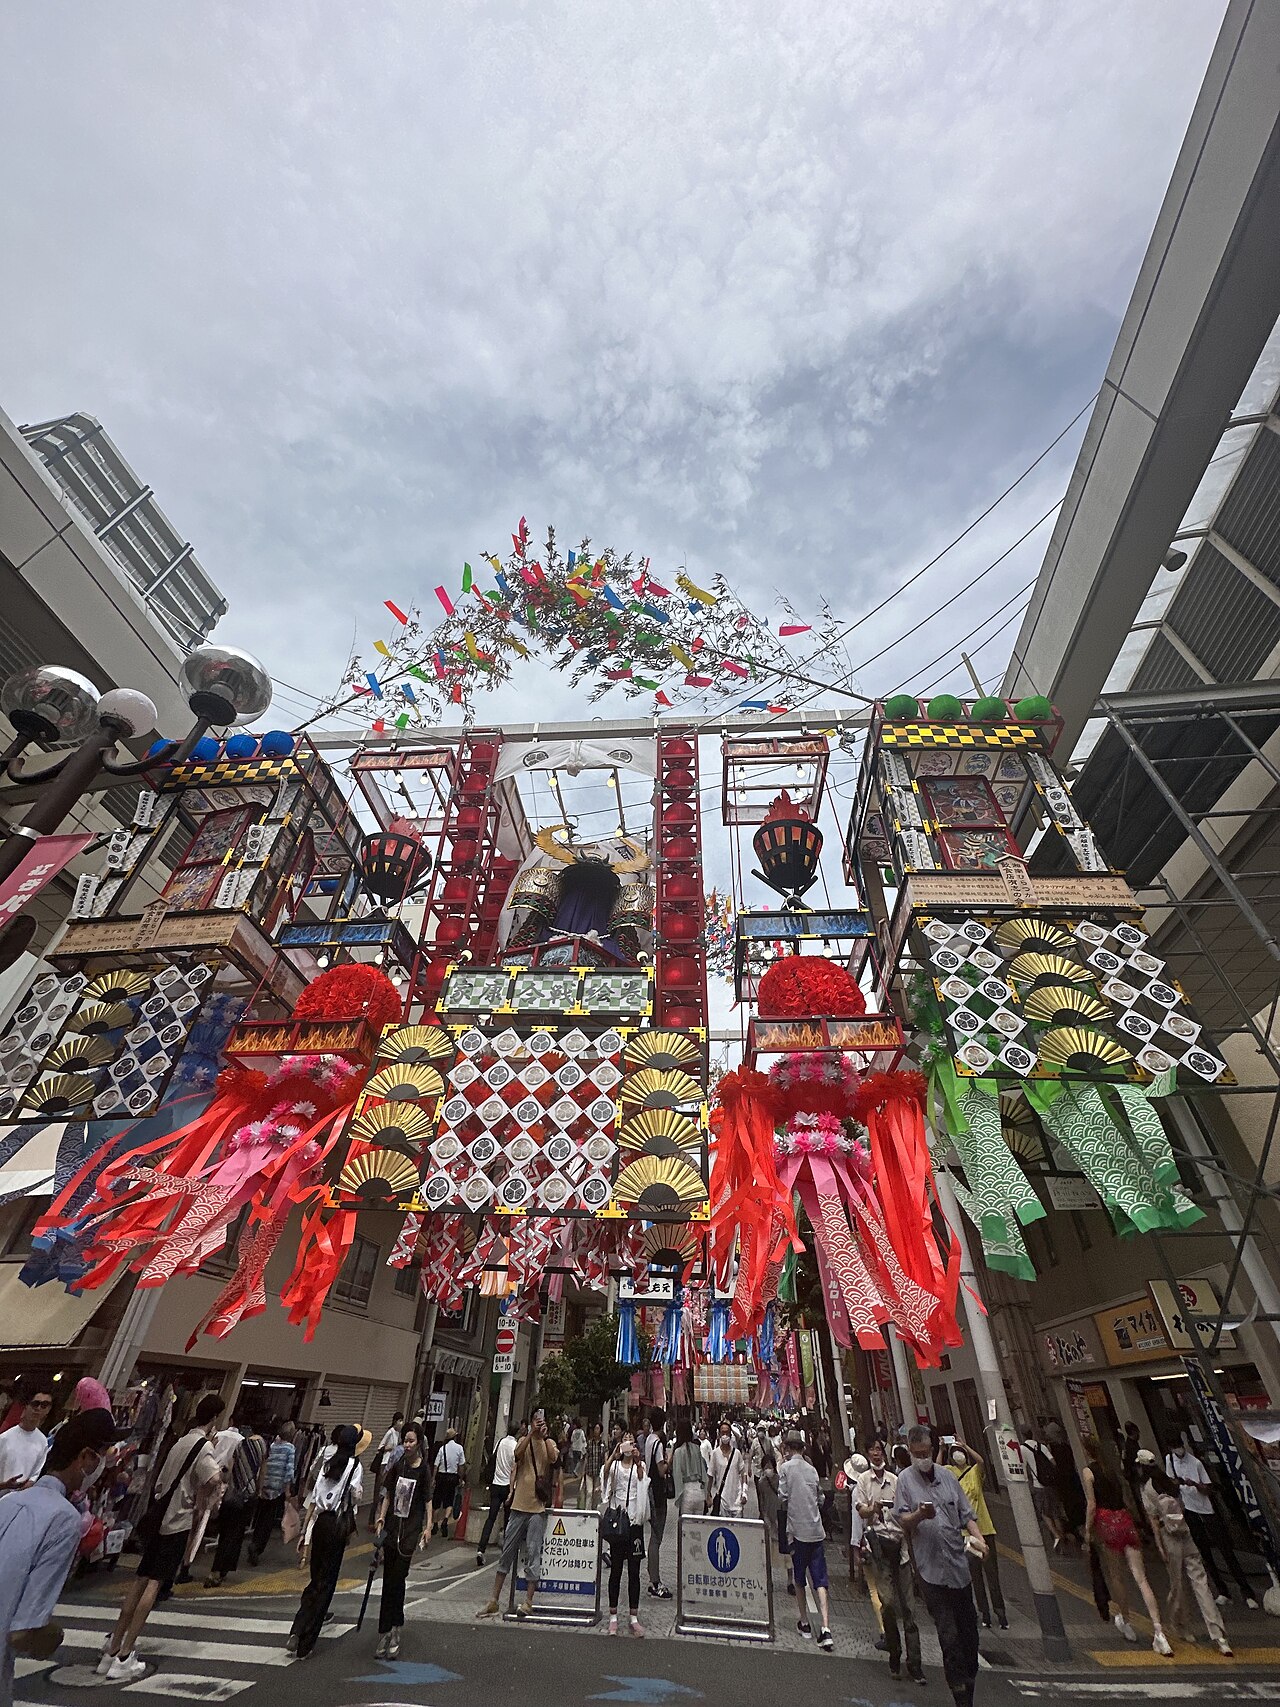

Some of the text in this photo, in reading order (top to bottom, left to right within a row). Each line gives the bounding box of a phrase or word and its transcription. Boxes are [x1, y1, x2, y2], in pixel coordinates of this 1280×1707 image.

[0, 863, 56, 922] 紅谷パ
[450, 979, 647, 1006] 家康合戦絵巻
[540, 1546, 569, 1556] ください
[541, 1537, 595, 1548] しのための駐車は
